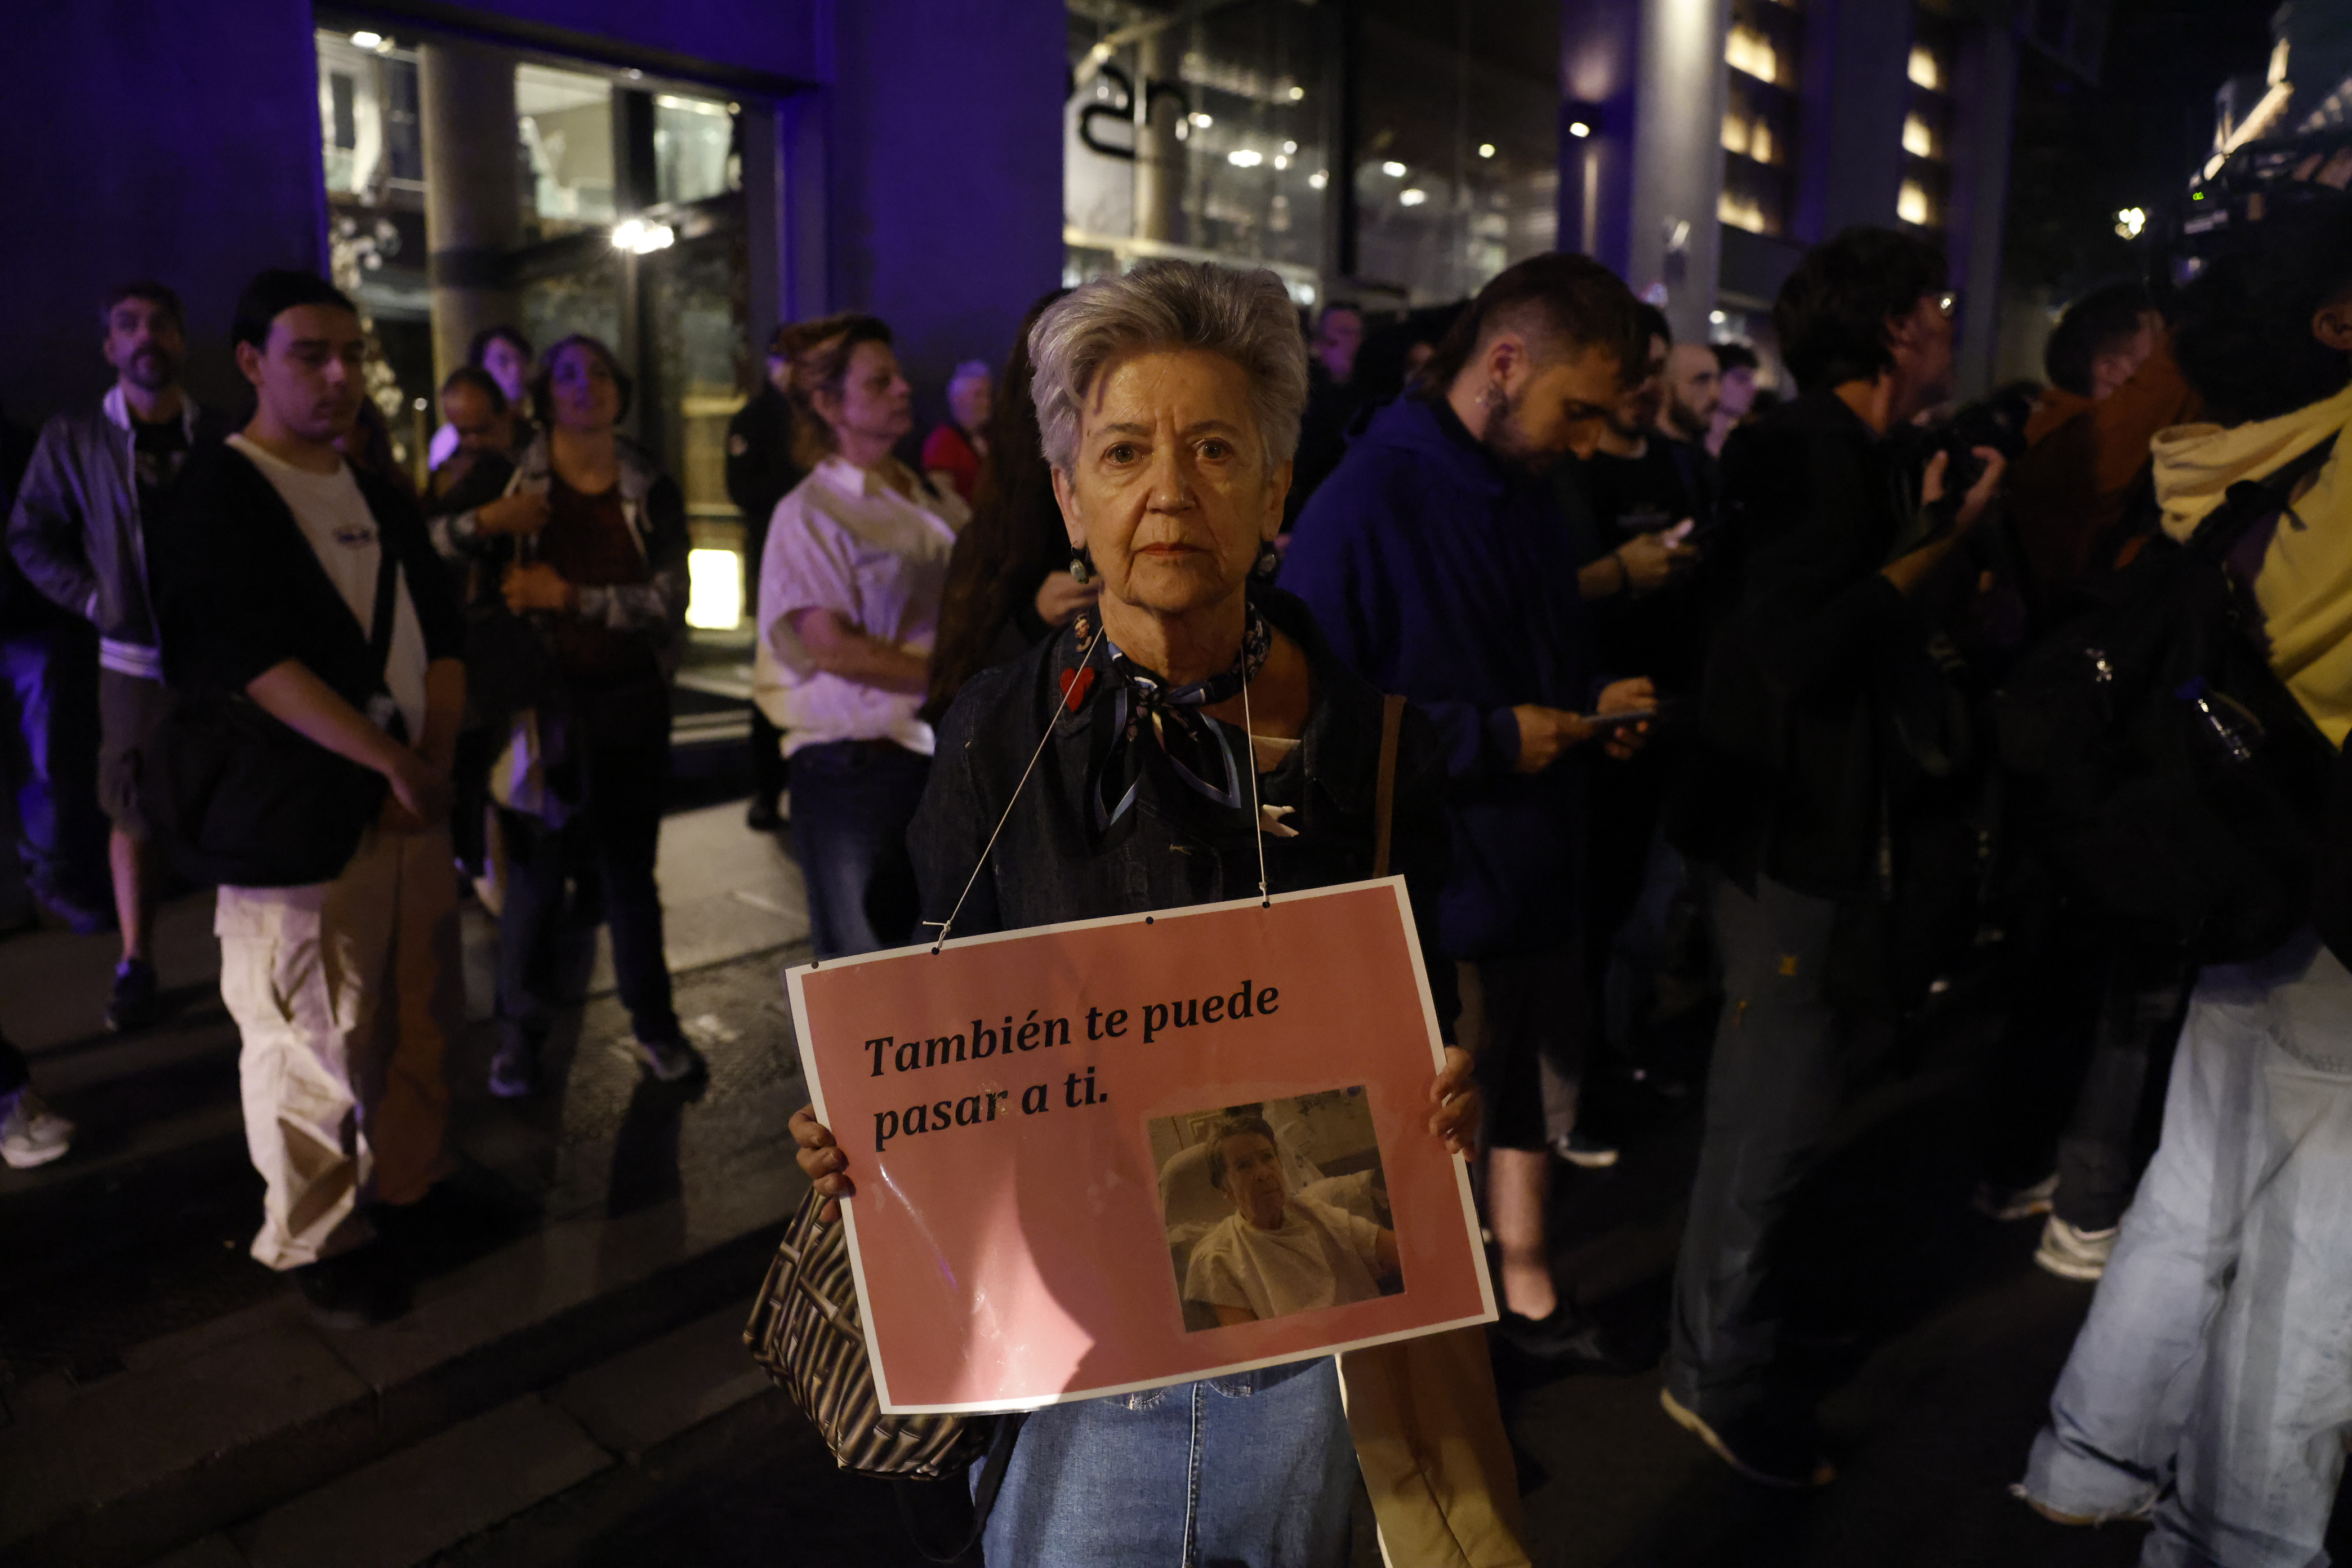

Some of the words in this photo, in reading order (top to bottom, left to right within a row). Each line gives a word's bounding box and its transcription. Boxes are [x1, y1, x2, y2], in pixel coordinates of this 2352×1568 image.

[865, 1009, 1071, 1077] También
[1085, 1006, 1128, 1041] te
[1142, 979, 1279, 1044] puede
[874, 1090, 1009, 1152] pasar
[1022, 1084, 1049, 1115] a
[1063, 1066, 1108, 1108] ti.
